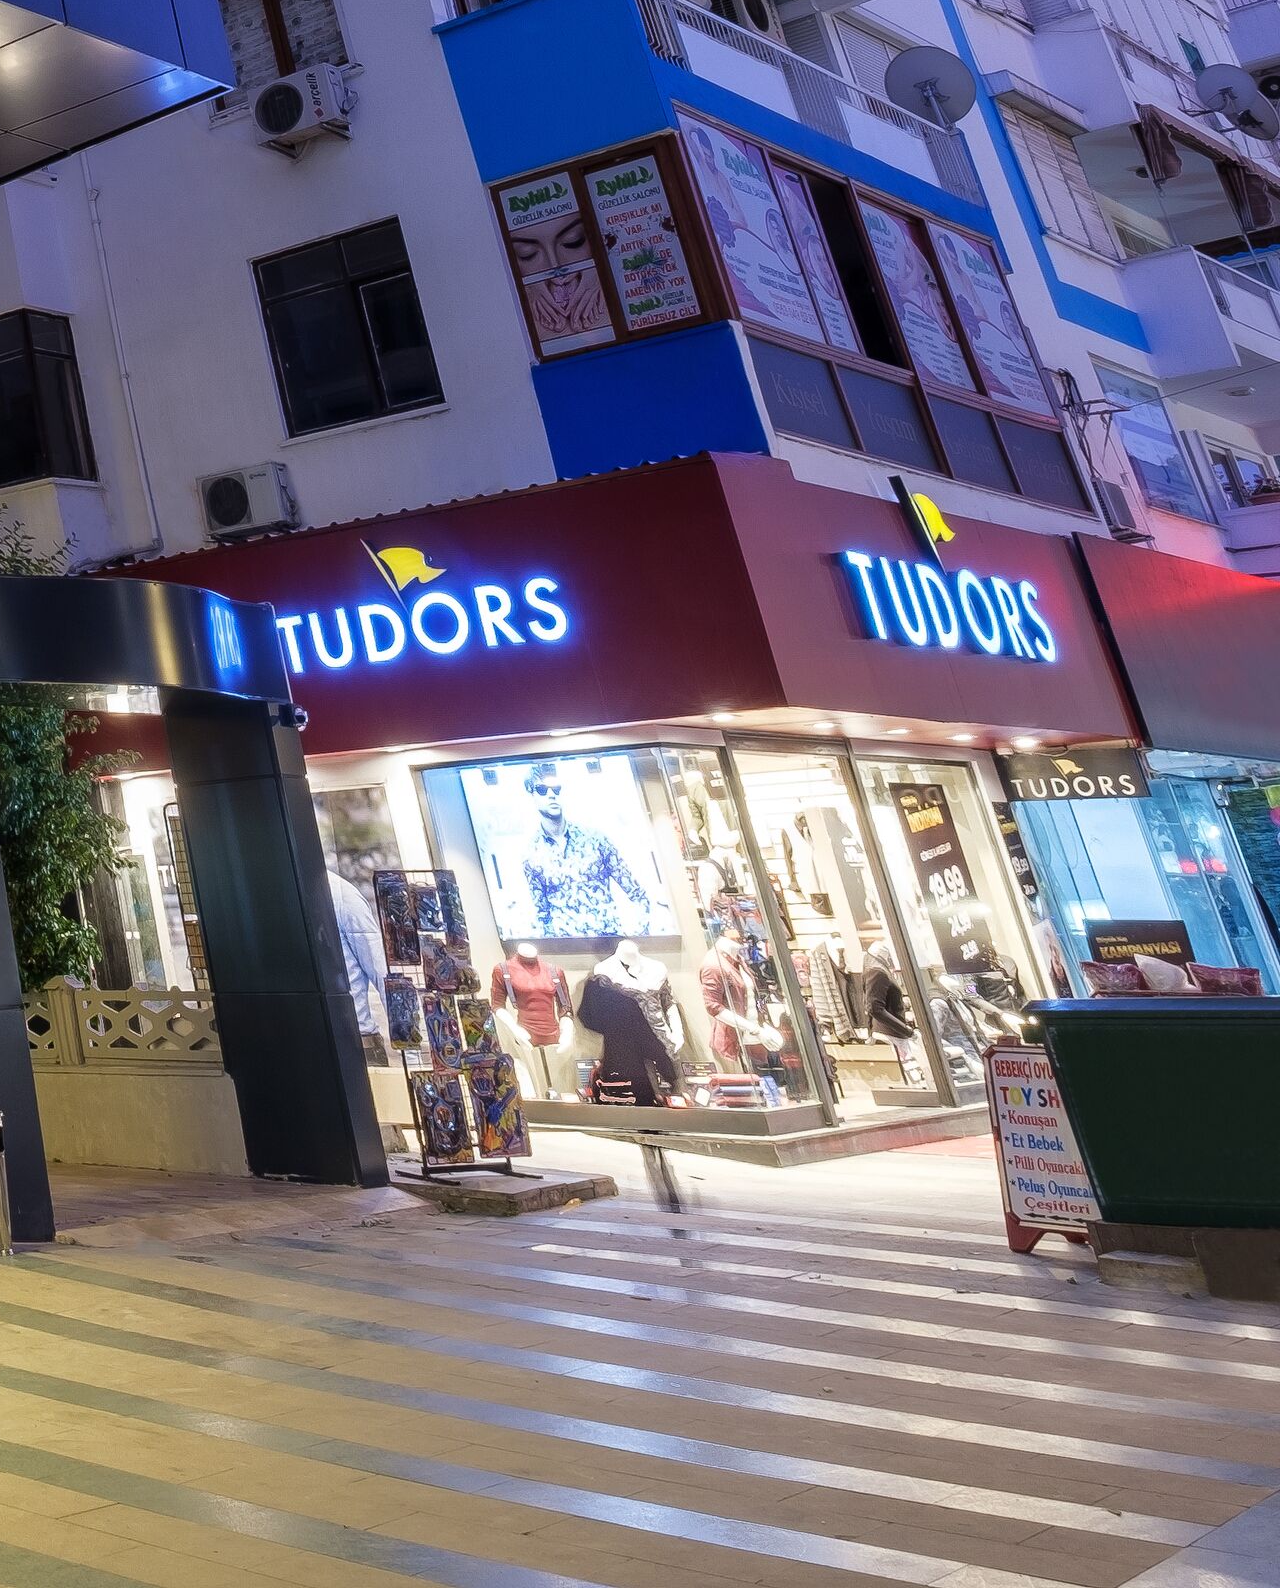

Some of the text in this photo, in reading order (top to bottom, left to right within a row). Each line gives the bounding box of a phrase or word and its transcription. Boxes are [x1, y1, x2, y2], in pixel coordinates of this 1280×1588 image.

[598, 186, 661, 211] GÜZELLİK SALONU
[512, 201, 573, 226] GÜZELLİK SALONU
[647, 233, 666, 248] YOK
[668, 276, 687, 288] YOK
[630, 305, 697, 329] PÜRÜZSÜZ CİLT
[844, 549, 1057, 663] TUDORS
[276, 576, 569, 675] TUDORS
[1010, 774, 1136, 798] TUDORS
[999, 1086, 1062, 1109] TOY SH
[1008, 1110, 1058, 1132] Konuşan
[1011, 1132, 1065, 1152] Et Bebek
[1014, 1155, 1034, 1171] Pilli
[1017, 1177, 1046, 1197] Peluş
[1024, 1196, 1091, 1215] Çeşitleri
